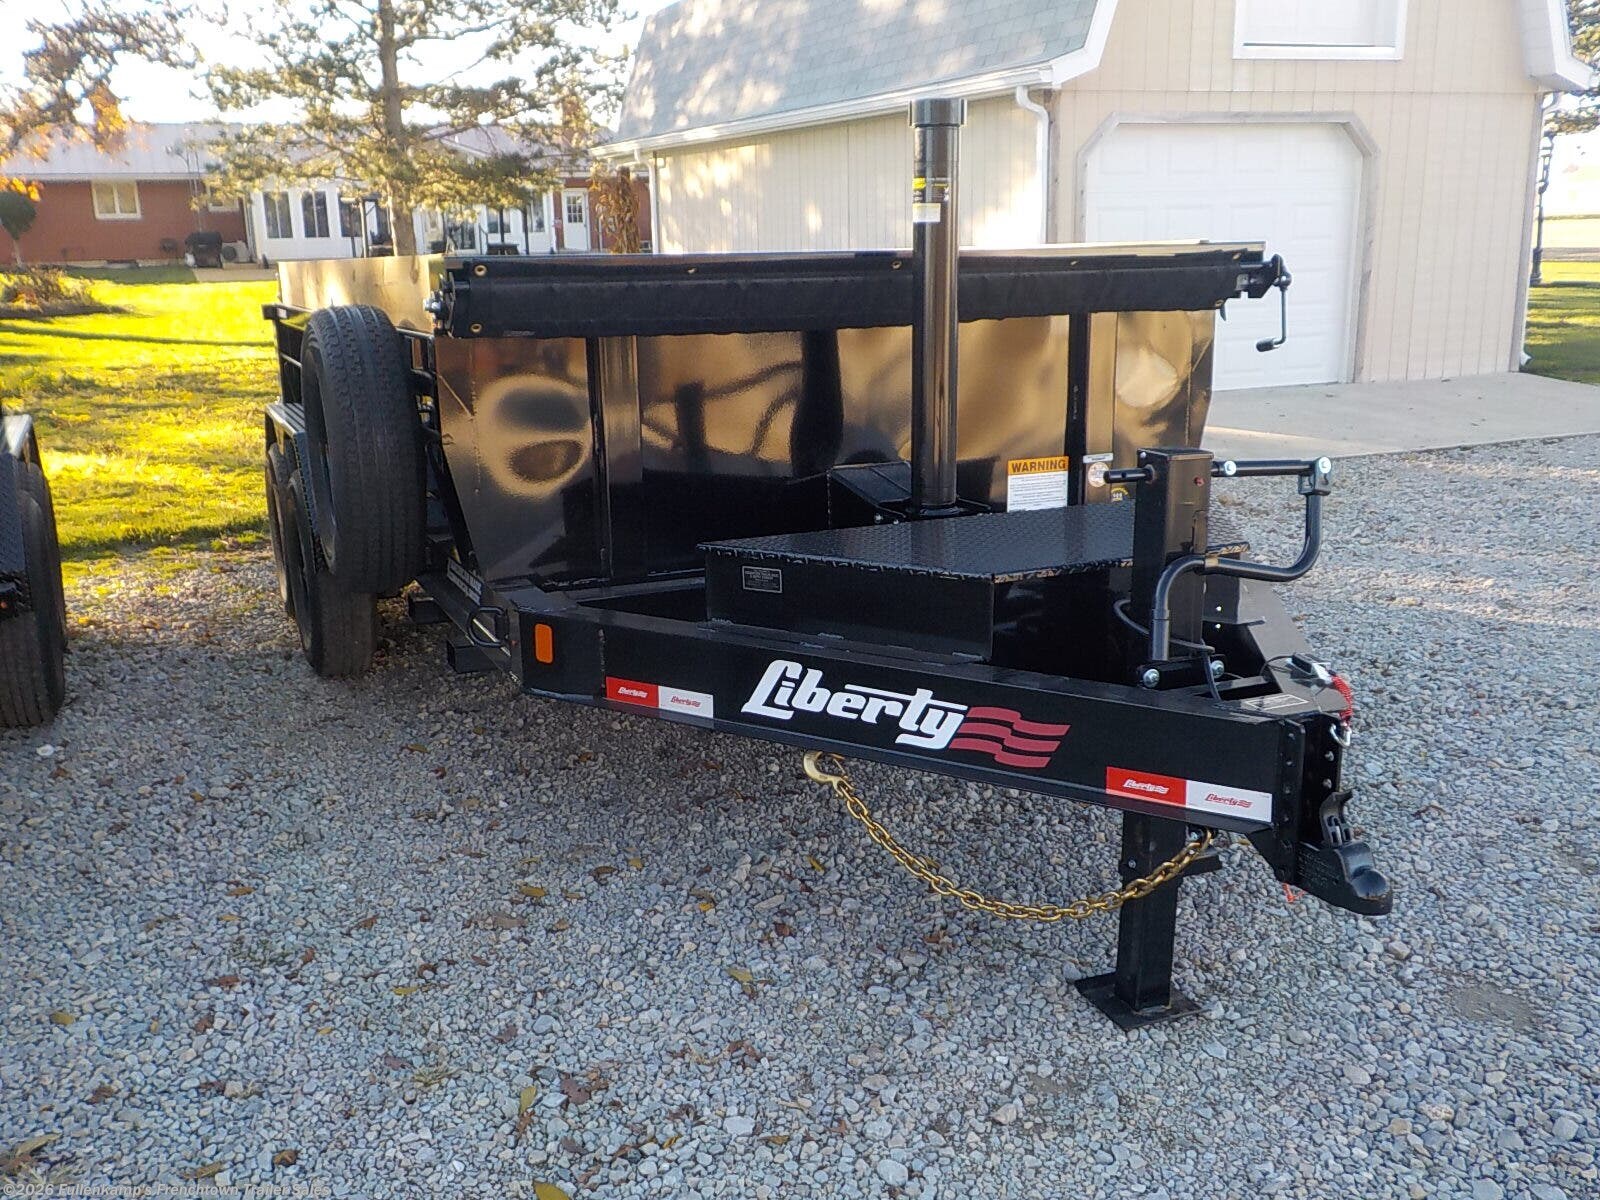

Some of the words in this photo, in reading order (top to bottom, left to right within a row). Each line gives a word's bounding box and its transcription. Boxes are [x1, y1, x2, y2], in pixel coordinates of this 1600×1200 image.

[1011, 459, 1067, 473] WARNING
[740, 659, 968, 751] Liberty
[1204, 793, 1238, 806] Liberty
